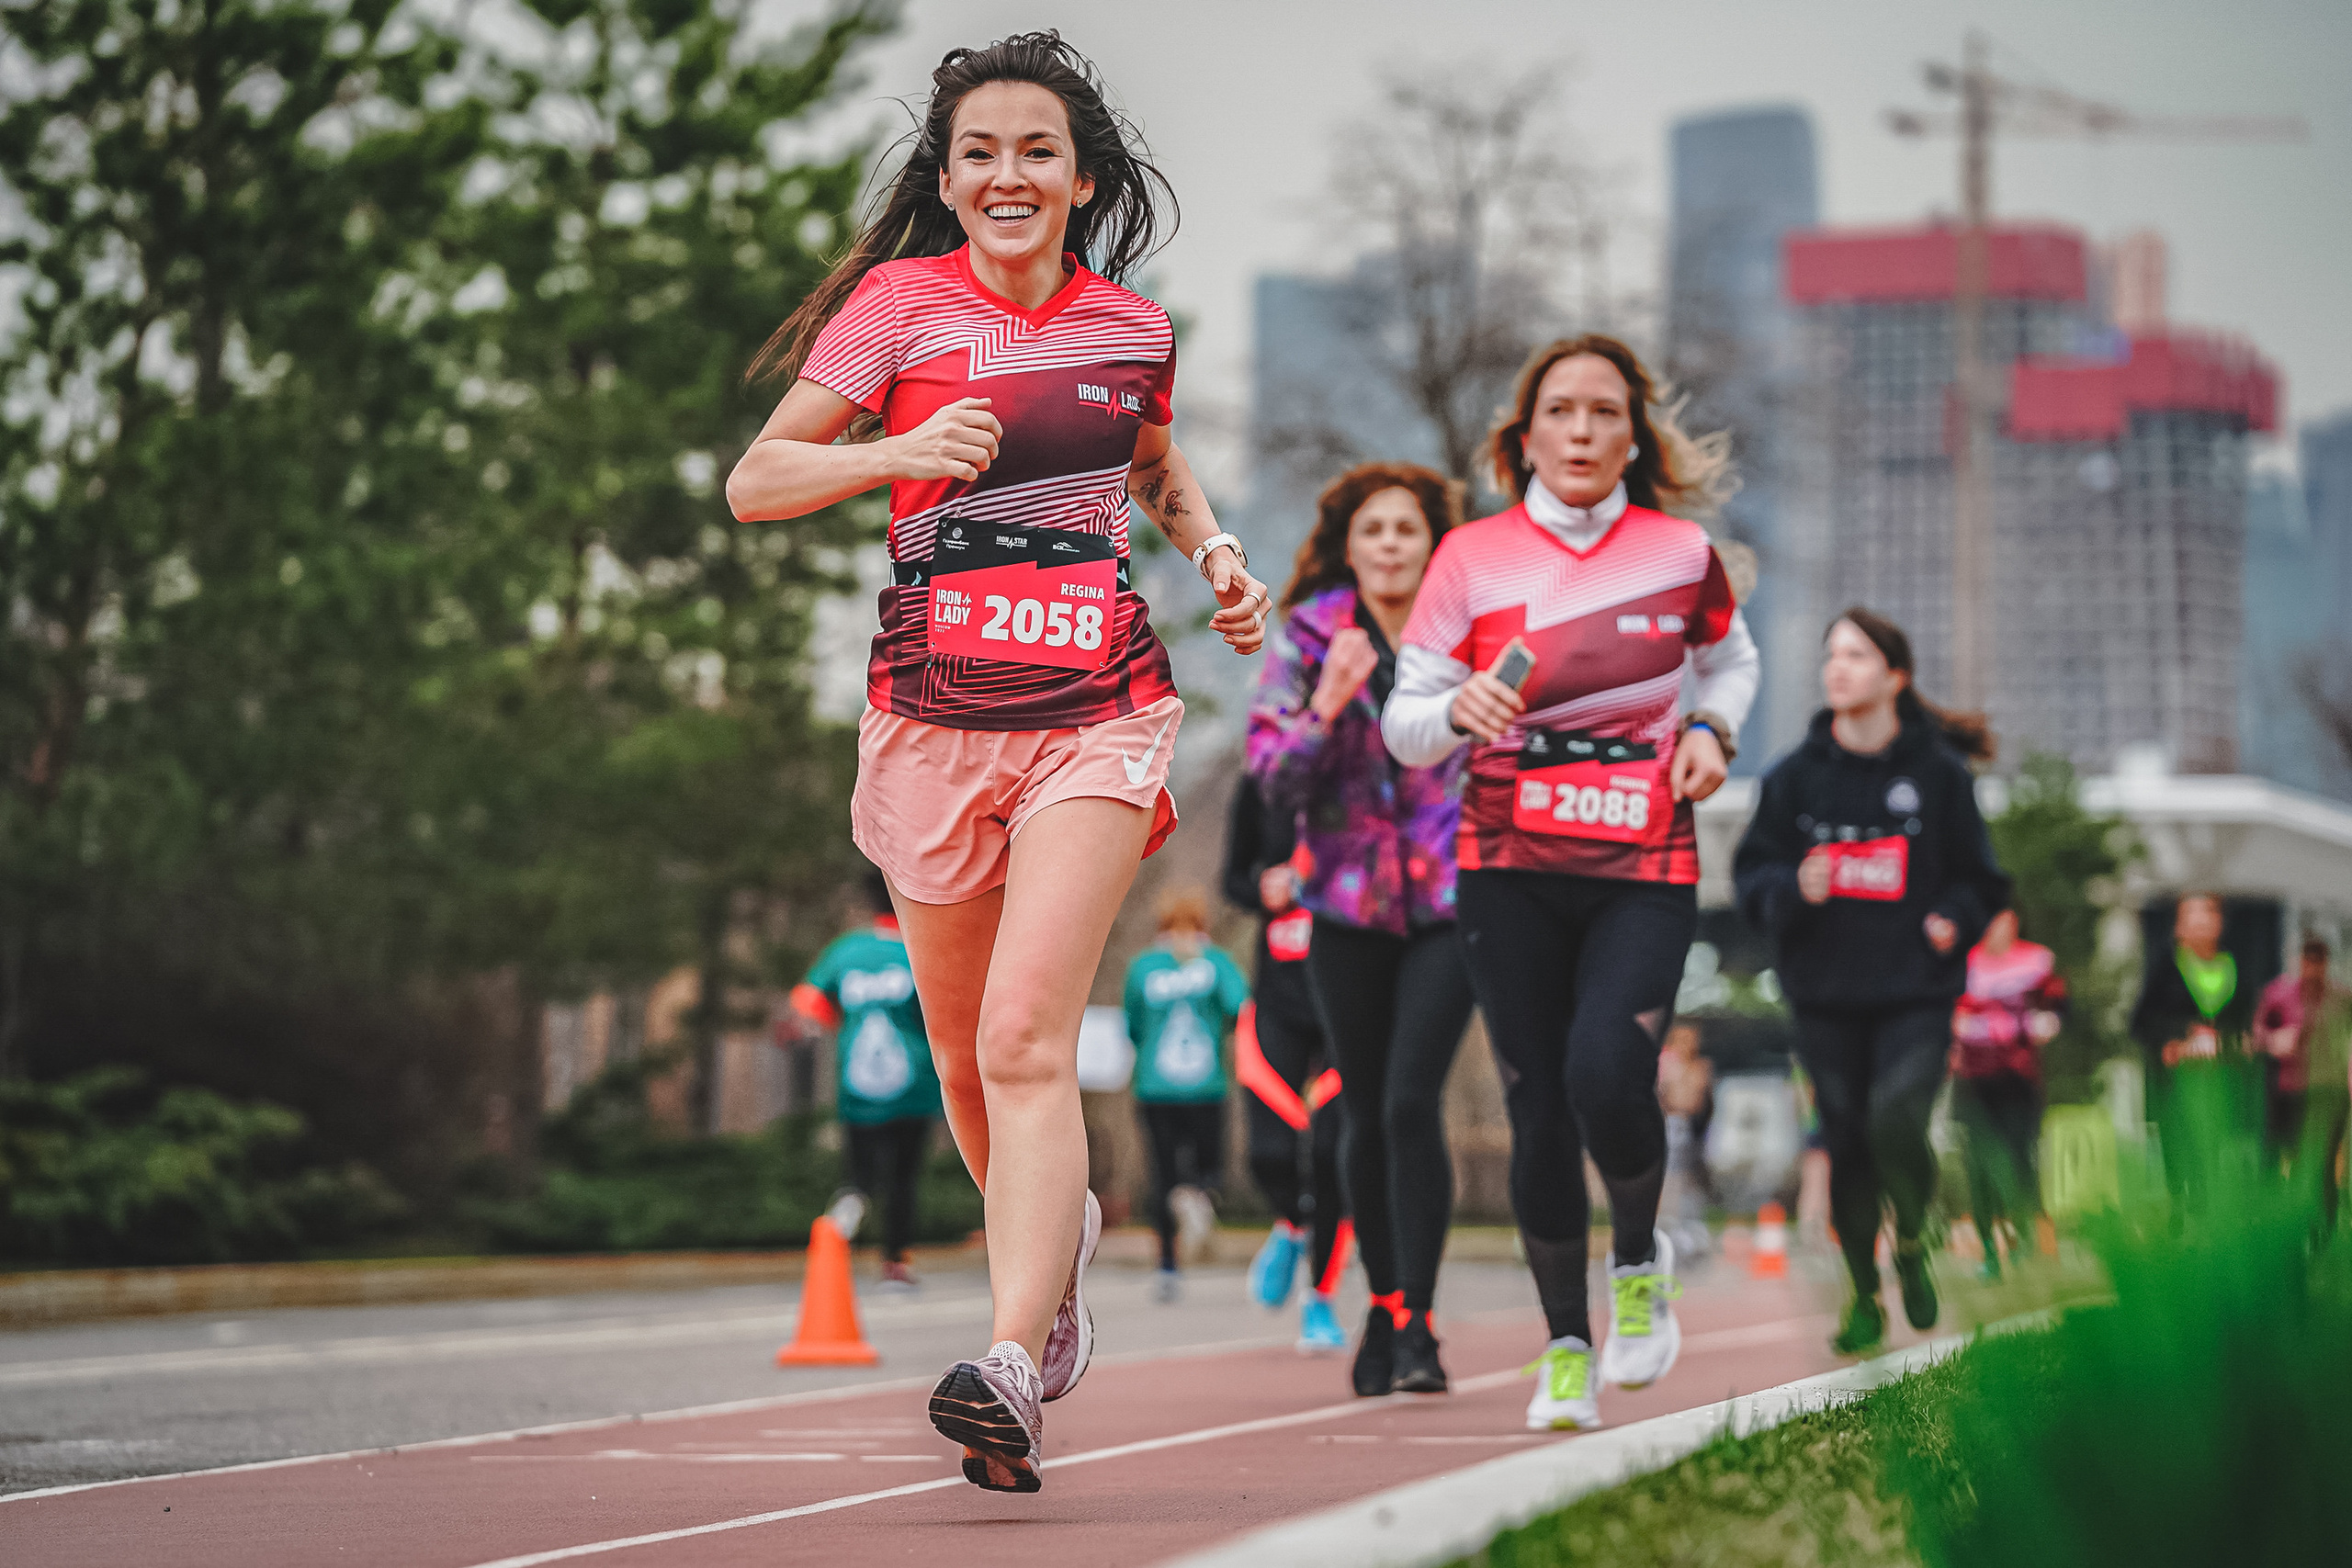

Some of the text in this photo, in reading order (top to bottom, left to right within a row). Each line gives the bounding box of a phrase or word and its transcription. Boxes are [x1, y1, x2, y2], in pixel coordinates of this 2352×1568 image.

[1078, 383, 1109, 403] IRON
[996, 536, 1010, 544] IRON
[936, 589, 962, 605] IRON
[1061, 582, 1105, 600] REGINA
[934, 604, 972, 626] LADY
[981, 595, 1103, 650] 2058
[1553, 783, 1650, 830] 2088
